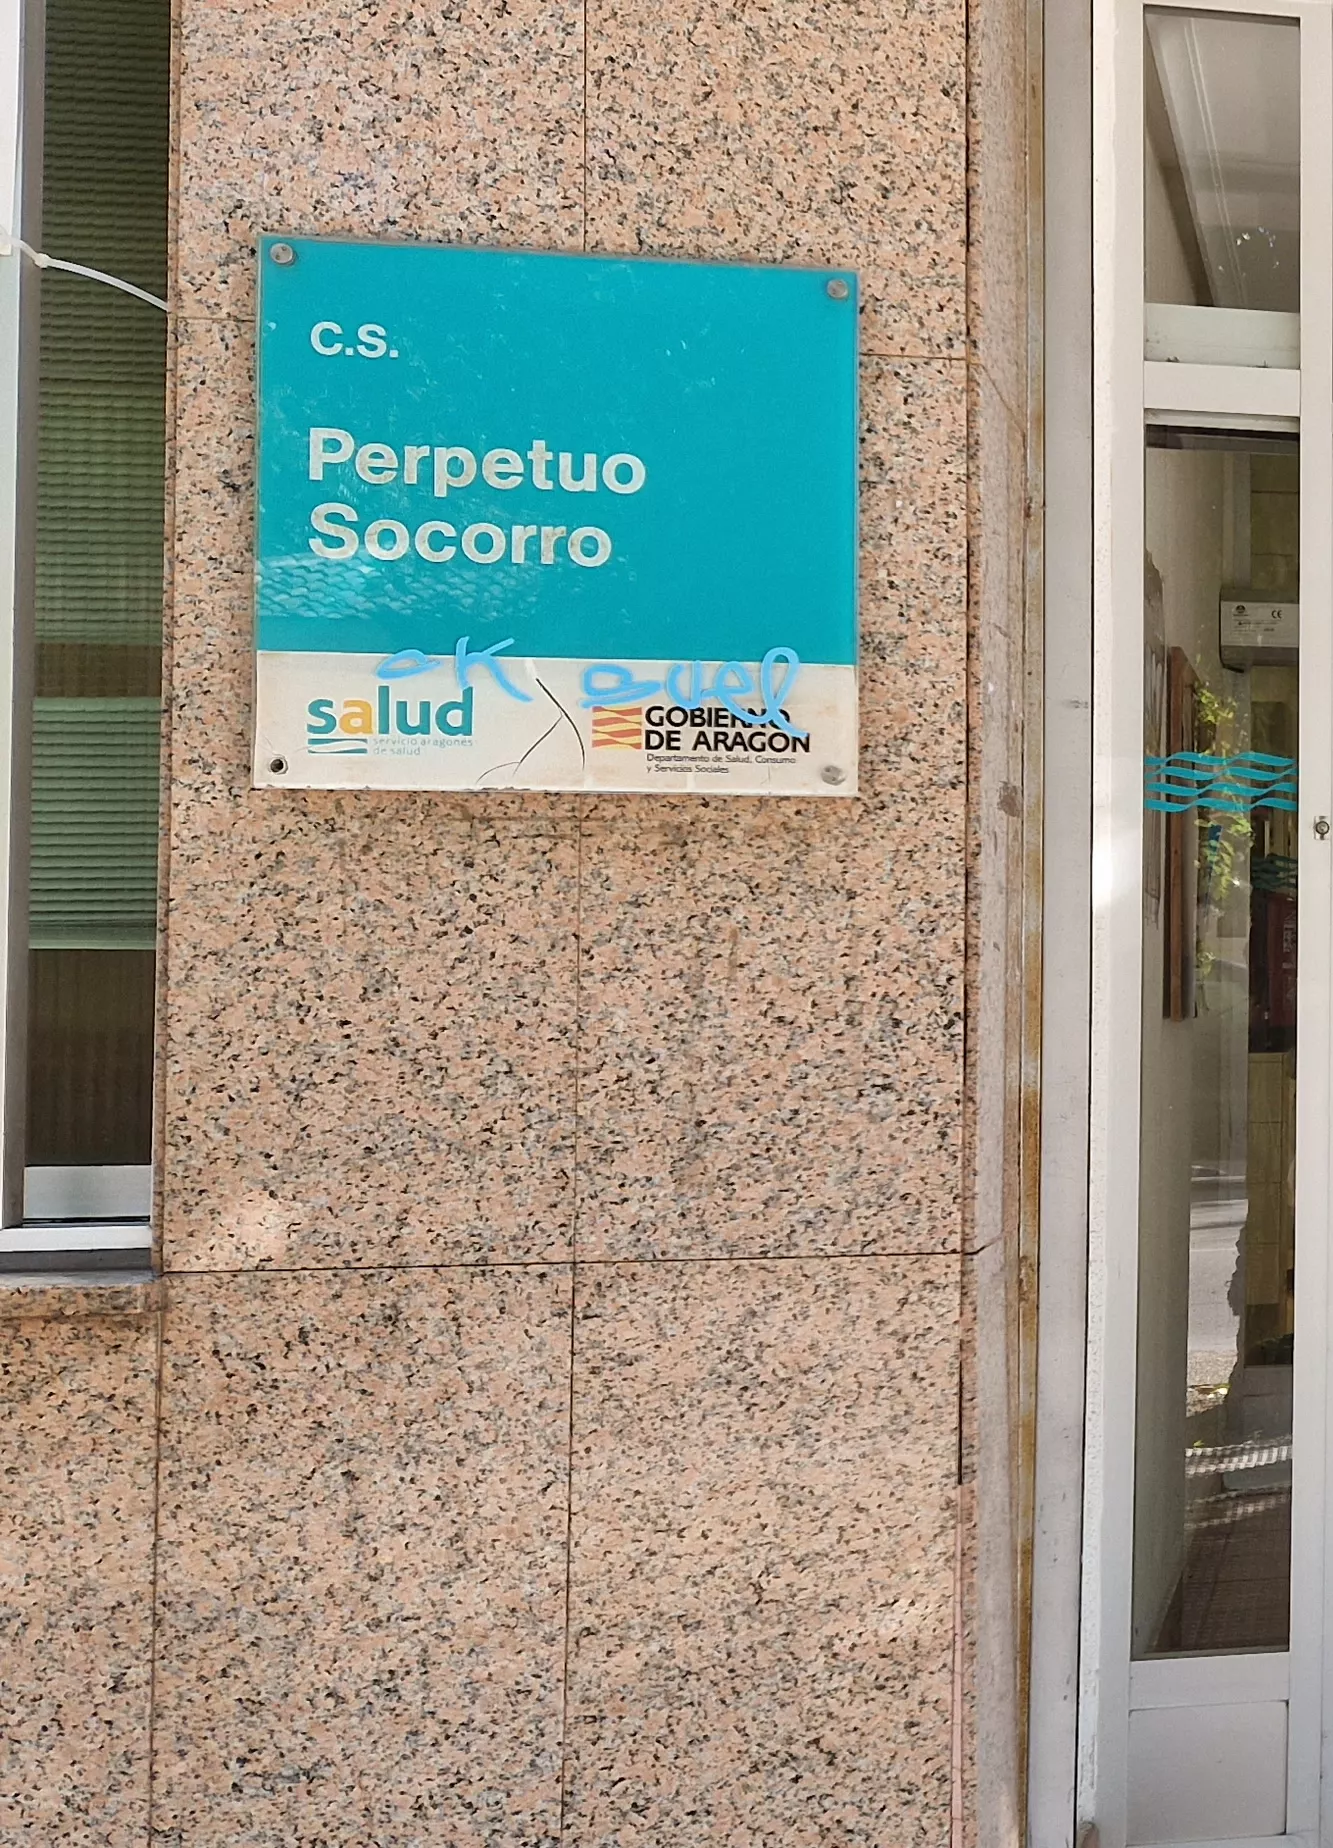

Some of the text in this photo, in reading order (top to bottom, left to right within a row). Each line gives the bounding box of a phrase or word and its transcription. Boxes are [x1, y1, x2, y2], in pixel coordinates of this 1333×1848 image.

[310, 321, 399, 358] C.S.
[308, 427, 646, 498] Perpetuo
[308, 502, 612, 567] Socorro
[307, 685, 474, 736] salud
[372, 737, 417, 747] servicio
[372, 747, 421, 756] de salud
[645, 729, 811, 753] DE ARAGON
[646, 753, 710, 764] Departamento
[712, 754, 724, 763] de
[755, 755, 796, 764] Consumo
[654, 764, 692, 773] Servicios
[694, 765, 730, 774] Sociales
